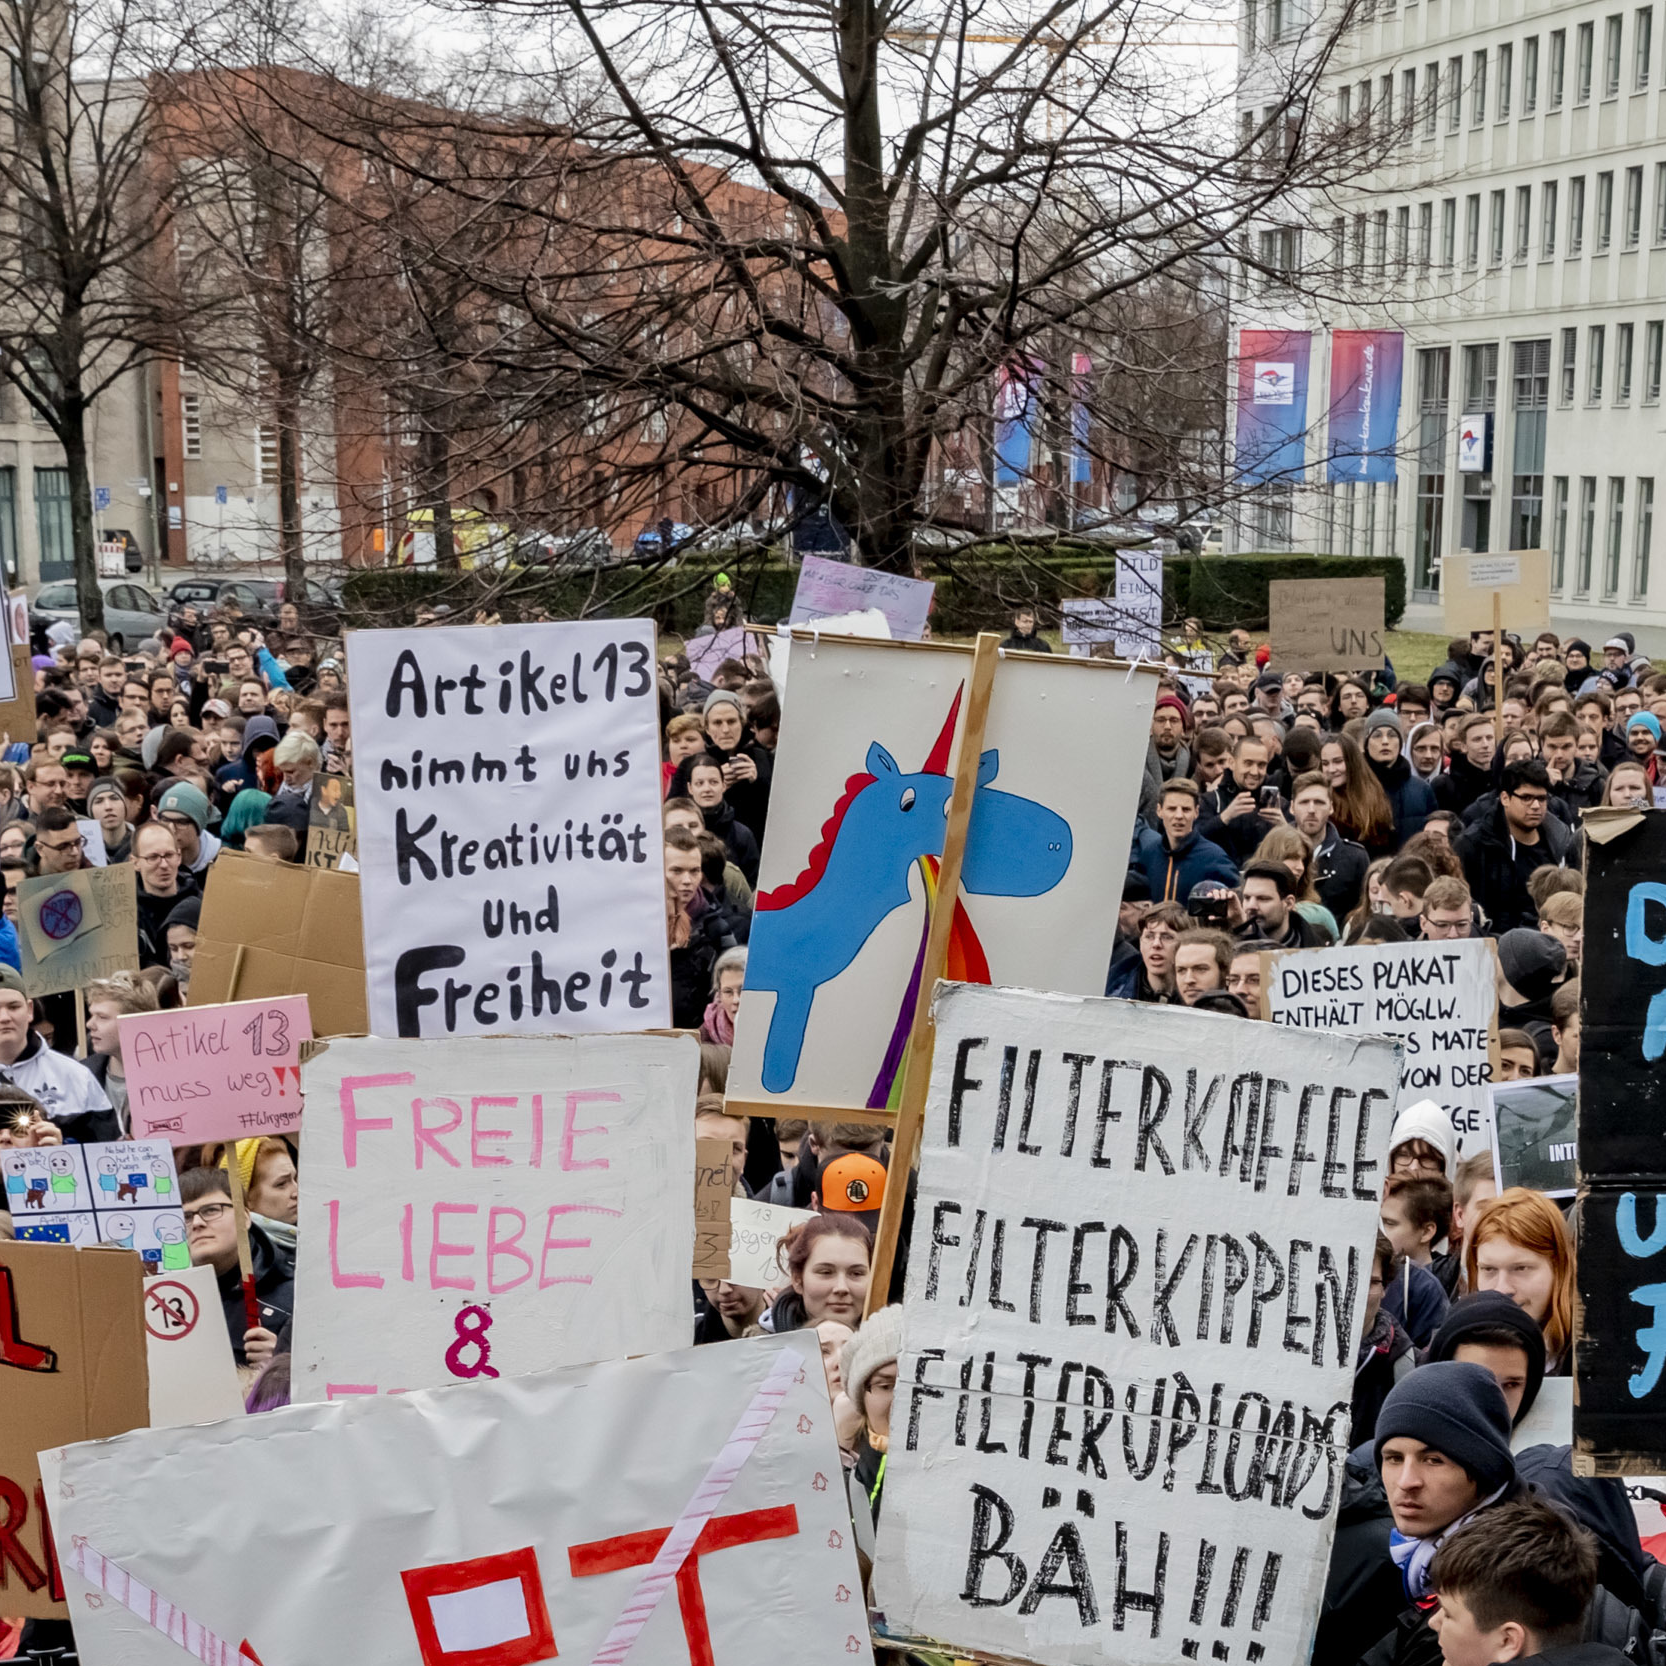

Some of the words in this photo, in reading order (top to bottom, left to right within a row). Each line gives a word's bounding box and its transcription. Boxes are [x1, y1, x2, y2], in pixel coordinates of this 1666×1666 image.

[1119, 556, 1159, 573] BILD
[1119, 581, 1159, 595] EINER
[1330, 629, 1384, 658] UNS
[380, 741, 536, 791] nimmt
[564, 750, 631, 780] uns
[395, 807, 648, 887] Kreativität
[393, 943, 653, 1037] Freiheit
[1282, 965, 1364, 999] DIESES
[1372, 955, 1462, 990] PLAKAT
[1375, 992, 1462, 1022] MÖGLW.
[134, 1017, 231, 1068] Artikel
[242, 1009, 292, 1057] 13
[138, 1079, 212, 1107] muss
[1451, 1061, 1495, 1089] DER
[338, 1071, 622, 1172] FREIE
[948, 1036, 1391, 1201] FILTERKAFFEE
[322, 1201, 624, 1293] LIEBE
[151, 1296, 185, 1328] 13
[924, 1200, 1360, 1369] FILTERKIPPEN
[444, 1304, 501, 1379] &
[905, 1348, 1351, 1521] FILTERUPLOADS
[960, 1481, 1284, 1664] BÄH!!!
